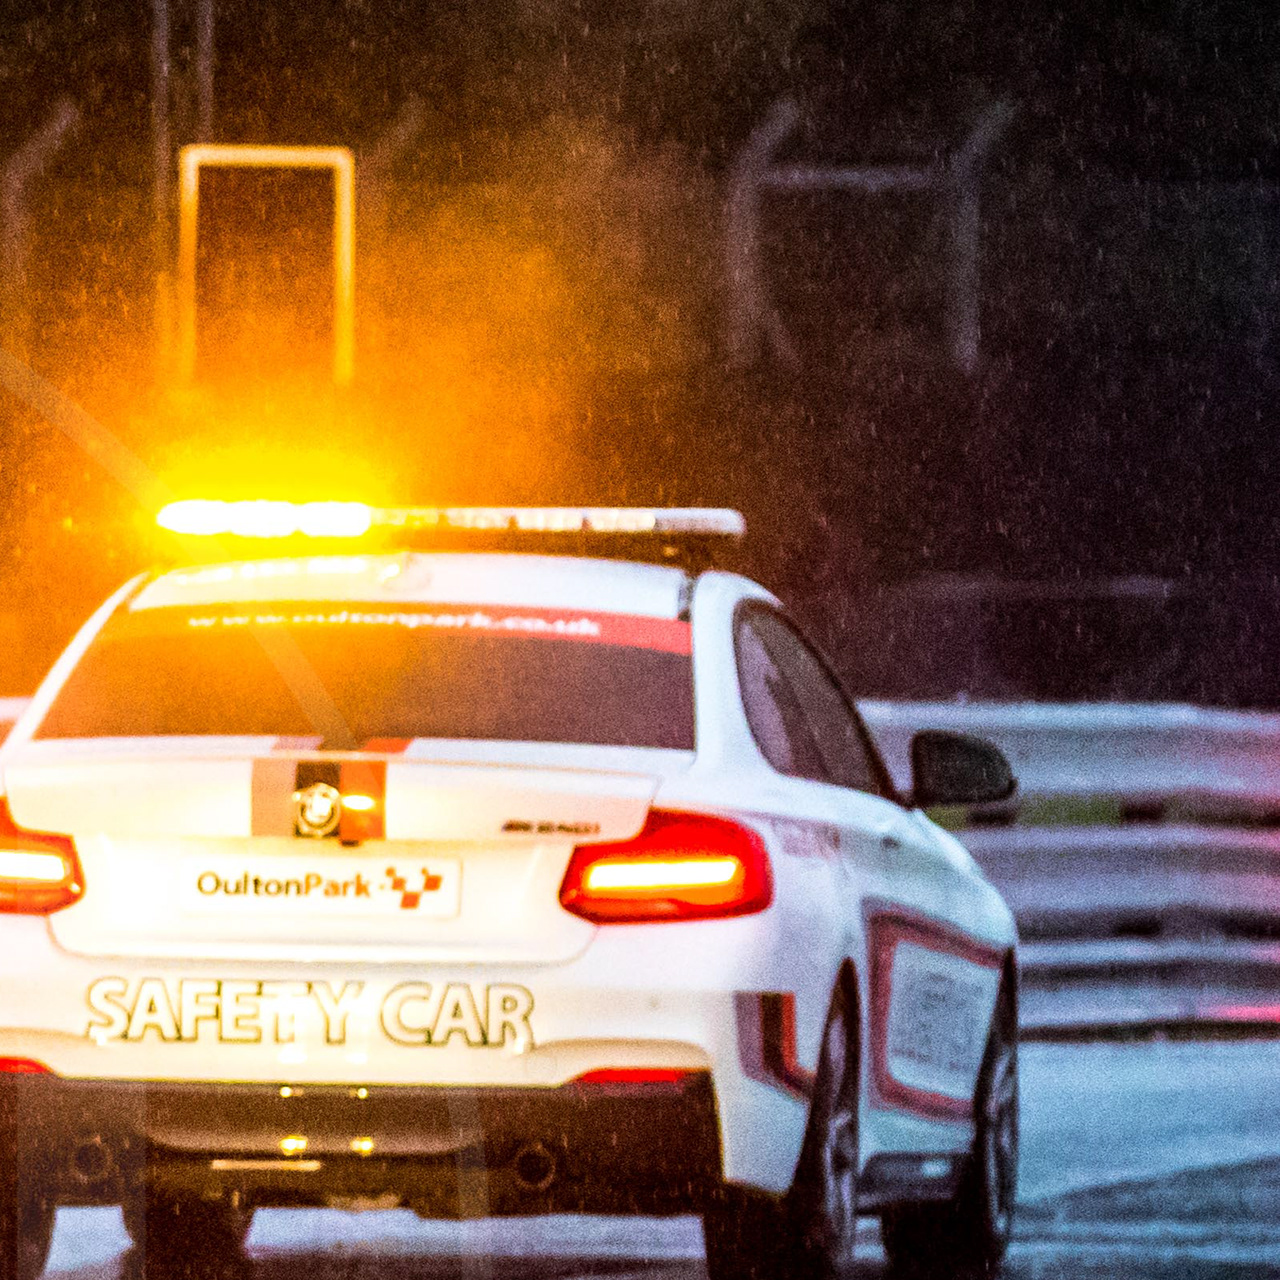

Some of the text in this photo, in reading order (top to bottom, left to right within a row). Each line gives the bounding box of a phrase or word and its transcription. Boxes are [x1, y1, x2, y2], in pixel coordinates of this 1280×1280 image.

[196, 869, 373, 898] OultonPark
[86, 974, 537, 1052] SAFETY CAR
